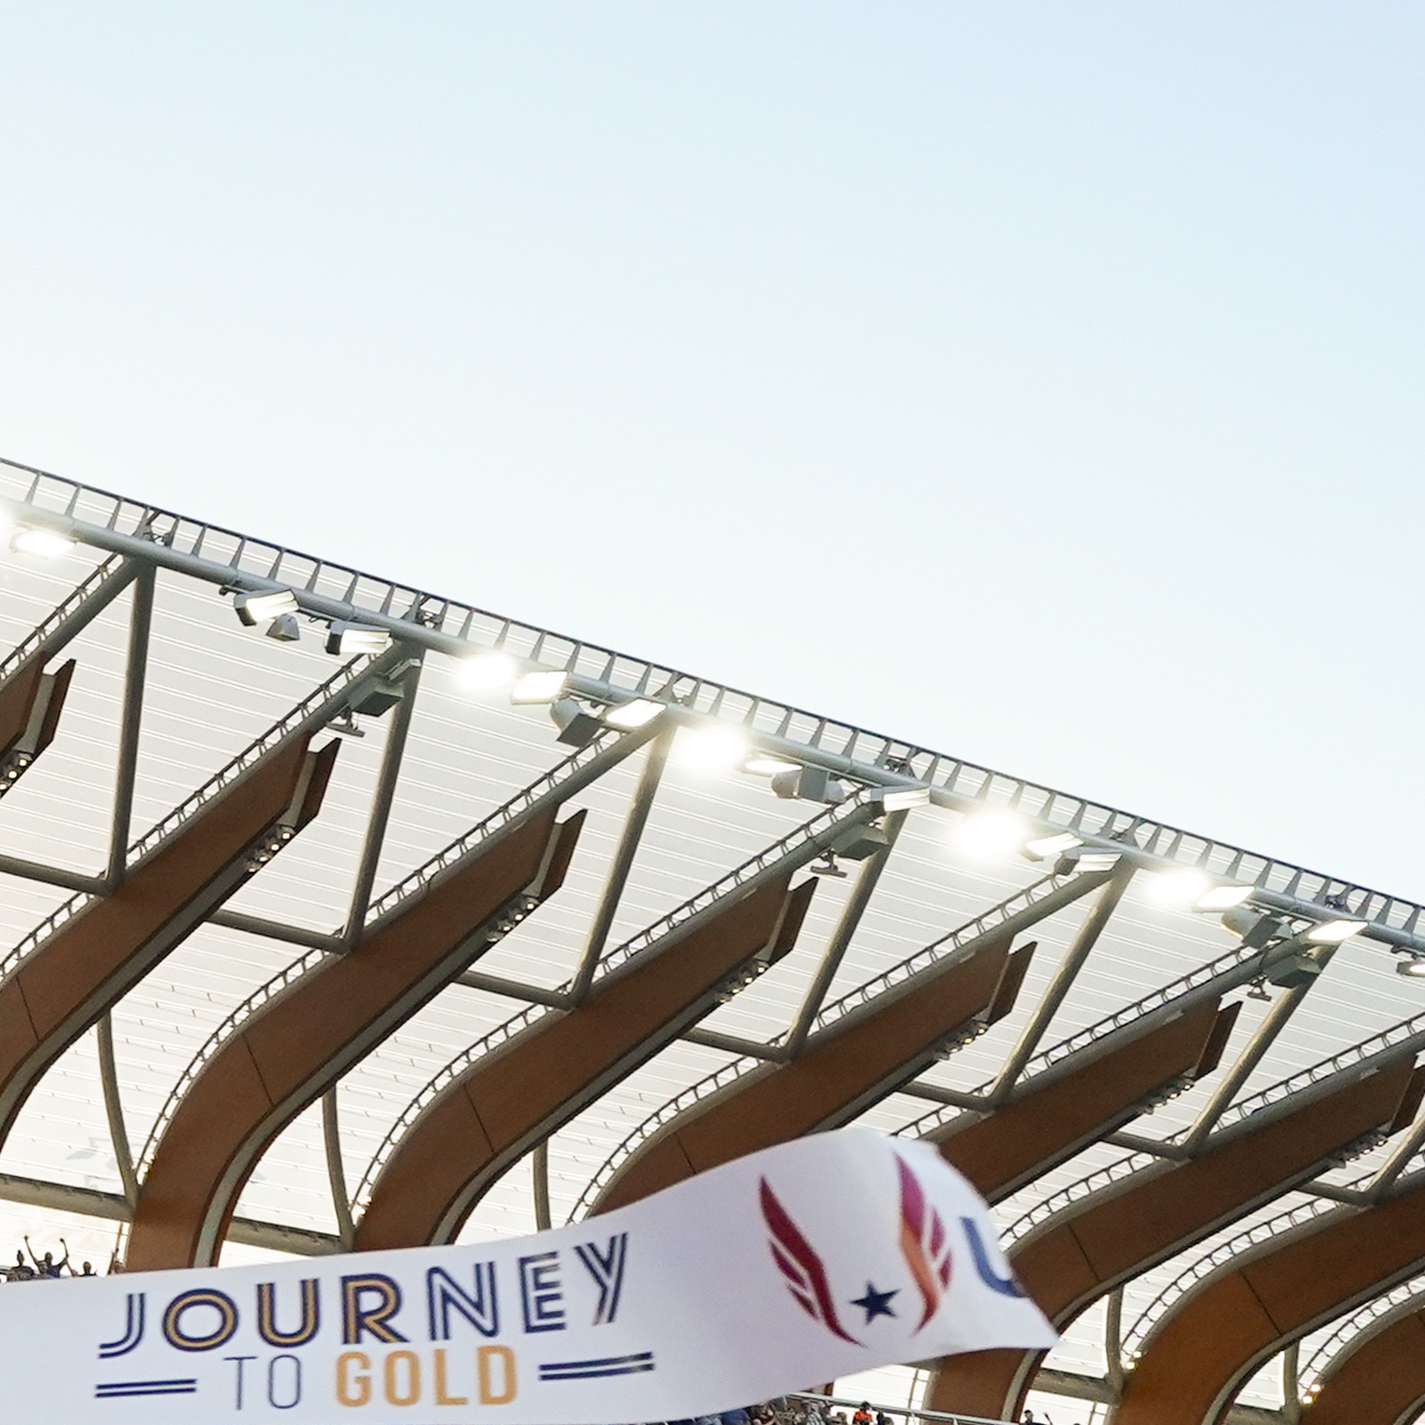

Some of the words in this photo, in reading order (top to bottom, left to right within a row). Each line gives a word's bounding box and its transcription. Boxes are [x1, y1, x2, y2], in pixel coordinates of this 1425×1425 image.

[98, 1233, 627, 1358] JOURNEY
[224, 1354, 303, 1410] TO
[336, 1344, 517, 1407] GOLD
